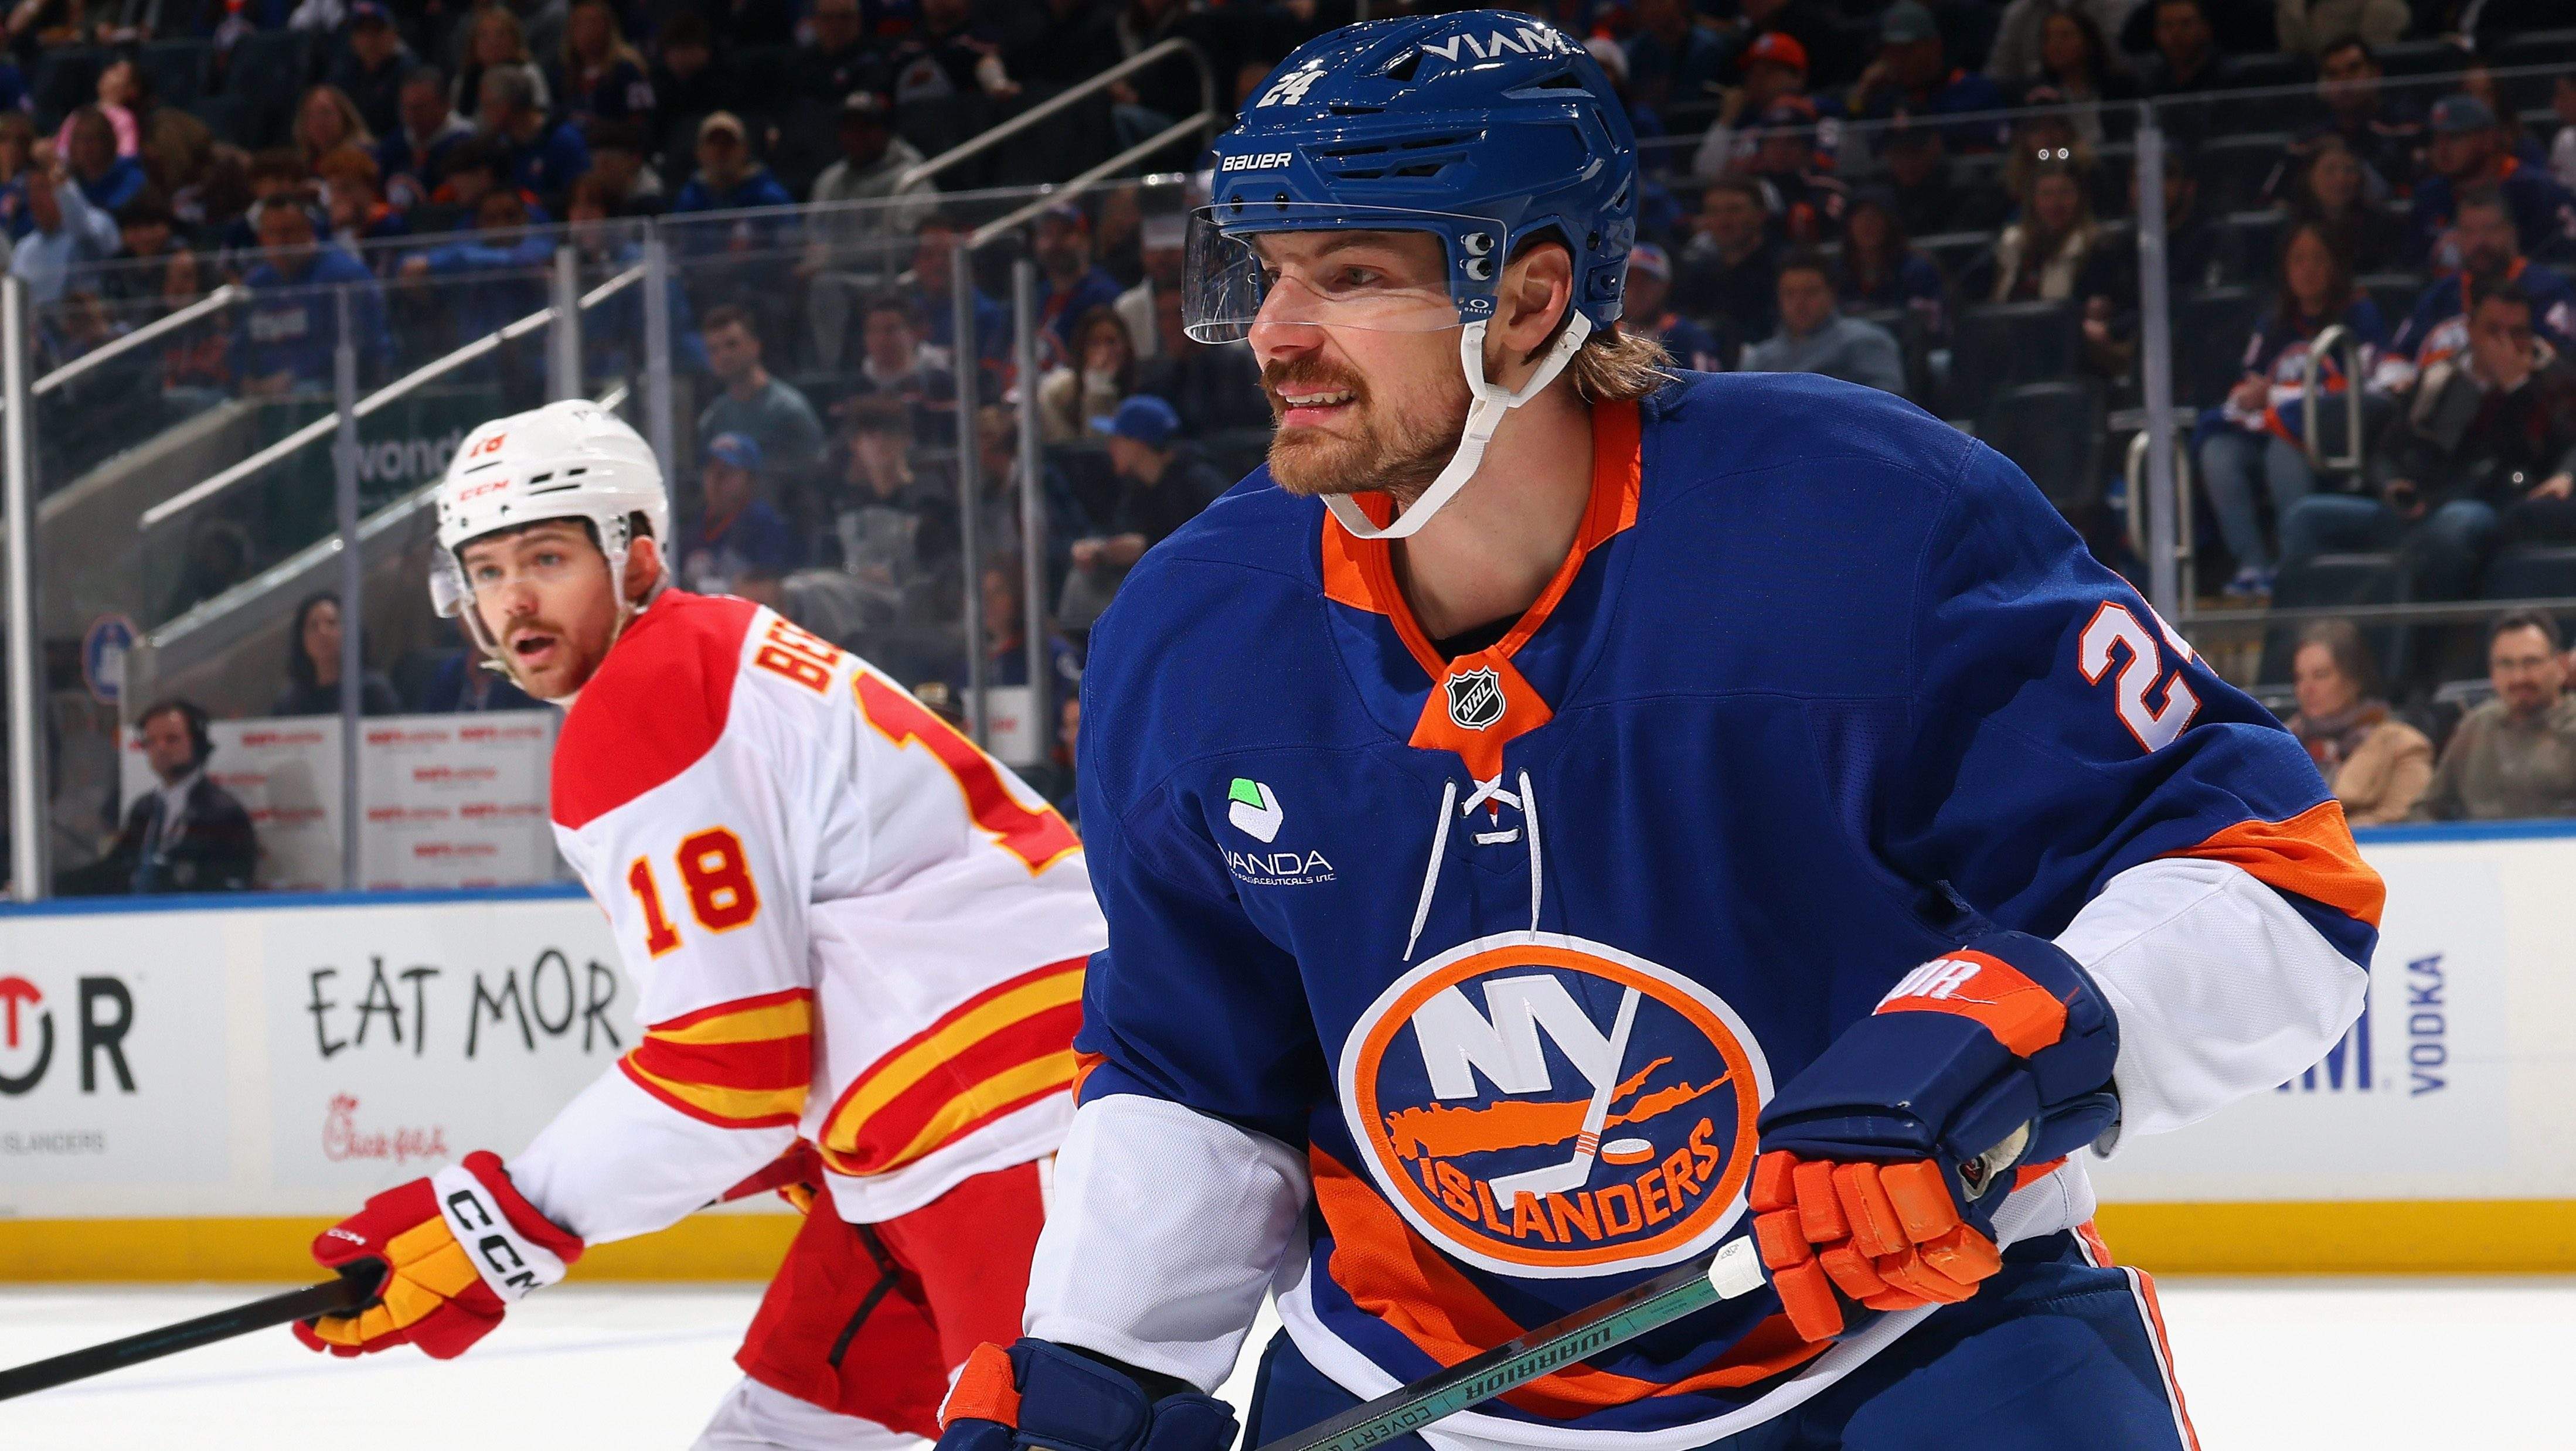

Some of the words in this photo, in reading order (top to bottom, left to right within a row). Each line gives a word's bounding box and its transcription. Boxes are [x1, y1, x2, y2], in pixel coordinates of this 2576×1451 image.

[1417, 27, 1571, 62] VIAM
[1255, 70, 1327, 108] 24
[459, 479, 509, 501] CCM
[1461, 682, 1491, 720] NHL
[1217, 843, 1333, 876] VANDA
[627, 824, 762, 961] 18
[307, 955, 441, 1056] EAT
[467, 948, 621, 1057] MOR
[2407, 952, 2446, 1097] VODKA
[1414, 1118, 1721, 1244] ISLANDERS
[448, 1189, 543, 1299] CCM
[1465, 1326, 1612, 1401] WARRIOR
[1349, 1406, 1432, 1450] COVERT
